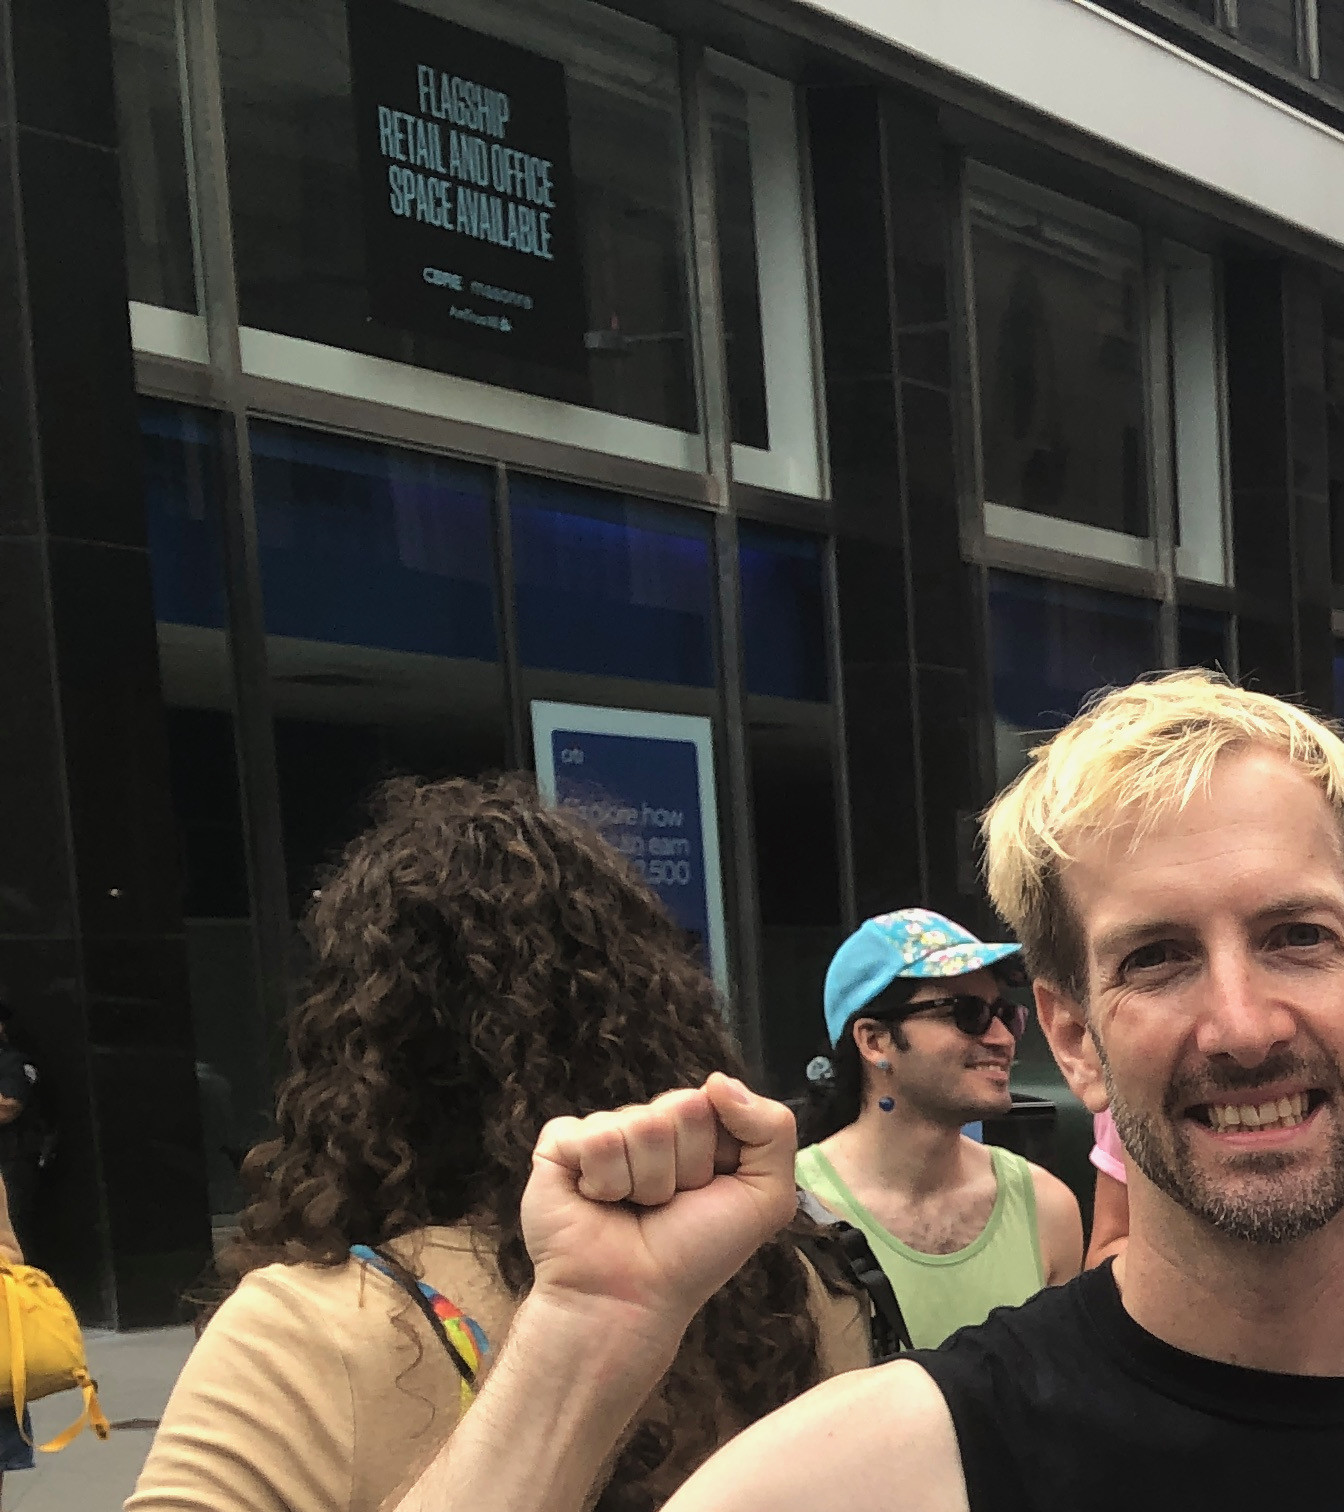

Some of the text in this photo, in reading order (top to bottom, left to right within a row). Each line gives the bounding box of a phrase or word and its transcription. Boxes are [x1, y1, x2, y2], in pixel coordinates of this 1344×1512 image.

[417, 63, 510, 139] FLAGSHIP
[377, 105, 556, 208] RETAIL AND OFFICE
[388, 164, 554, 261] SPACE AVAILABLE
